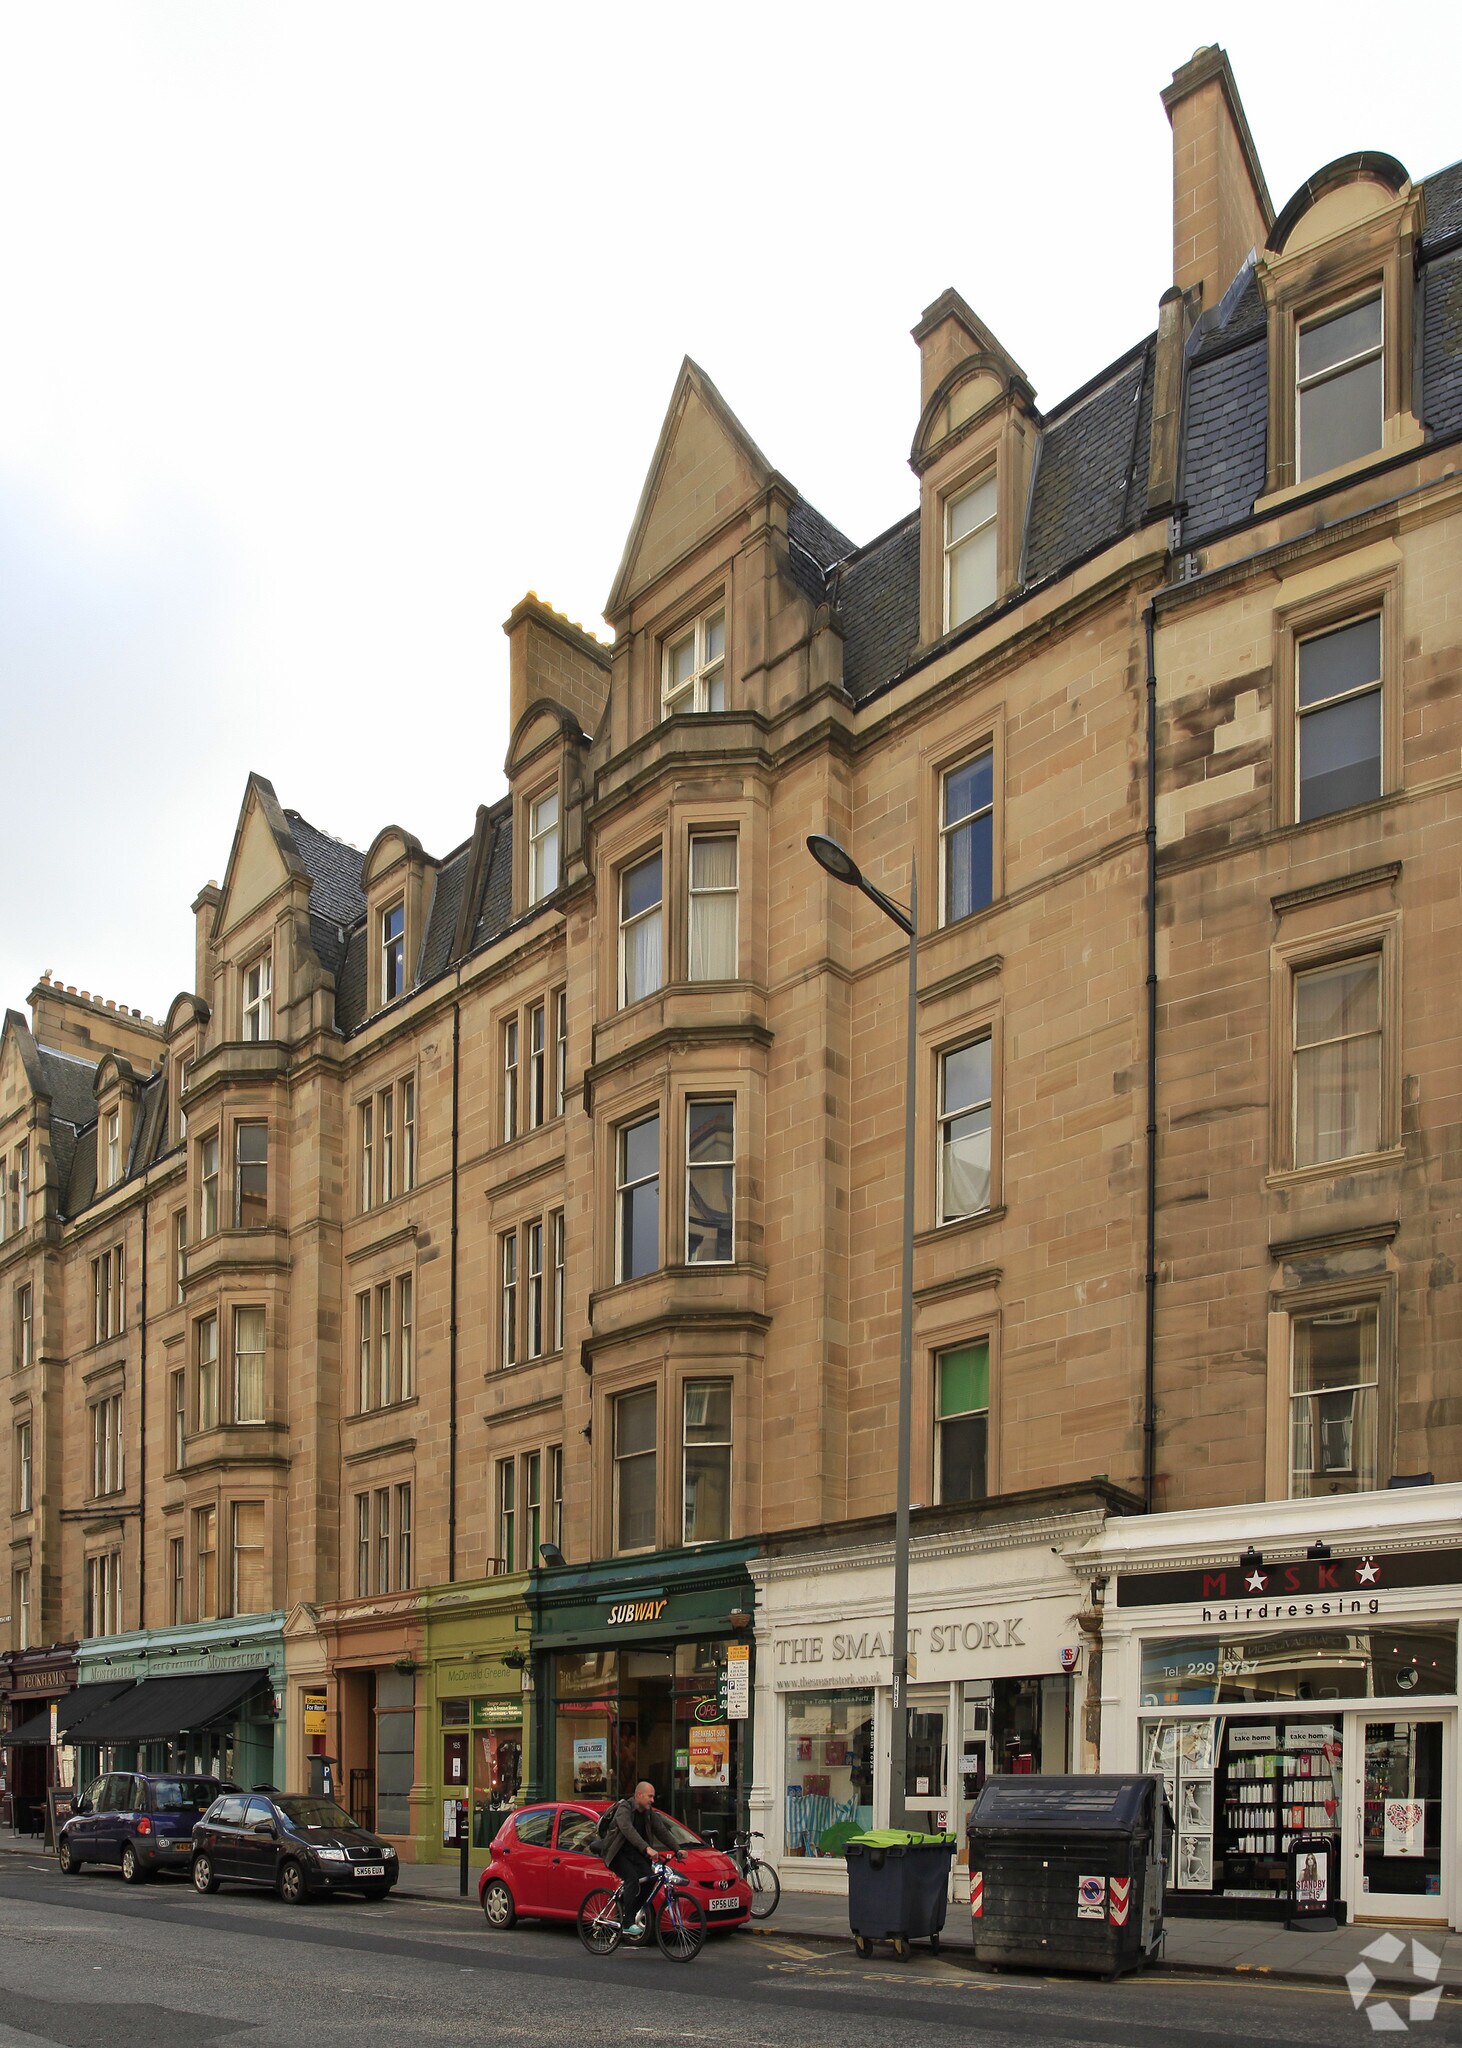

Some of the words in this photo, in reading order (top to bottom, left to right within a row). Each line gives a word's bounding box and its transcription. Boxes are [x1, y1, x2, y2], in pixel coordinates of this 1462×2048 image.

[607, 1599, 668, 1625] SUBWAY
[1202, 1599, 1379, 1622] hairdressing
[776, 1637, 824, 1665] THE
[930, 1617, 1026, 1653] STORK
[448, 1670, 483, 1682] McDonald
[484, 1668, 511, 1679] Greene
[1187, 1662, 1215, 1676] 229
[1223, 1660, 1259, 1675] 9757
[777, 1672, 881, 1689] www.thesmartstork.co.uk
[324, 1766, 330, 1776] P
[1296, 1879, 1326, 1890] STANDBY
